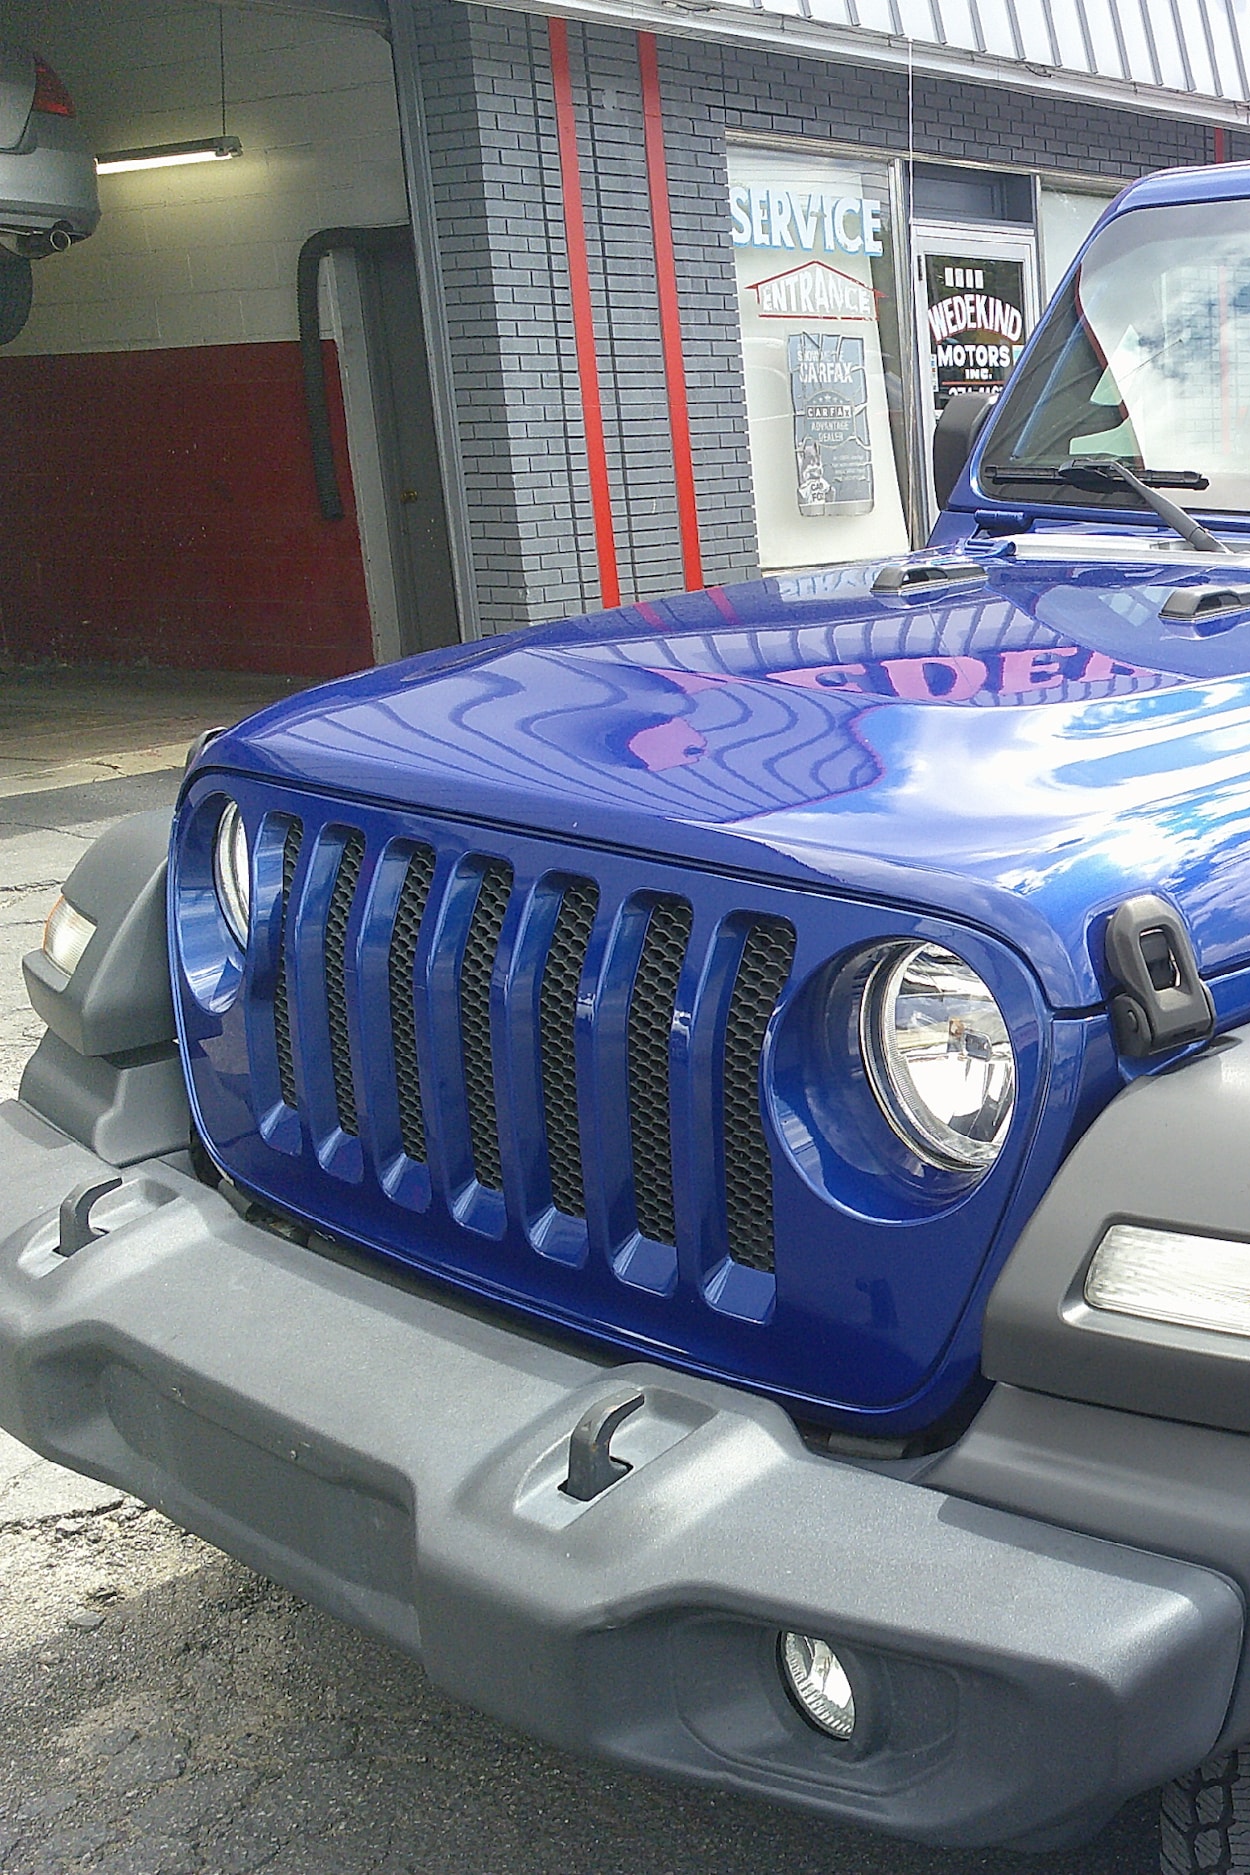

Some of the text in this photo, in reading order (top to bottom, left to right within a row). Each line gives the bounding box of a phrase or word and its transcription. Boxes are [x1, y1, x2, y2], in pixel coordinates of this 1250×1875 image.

[729, 187, 884, 257] SERVICE
[762, 267, 871, 315] ENTRANCE
[928, 293, 1023, 343] WEDEKIND
[937, 344, 1011, 368] MOTORS
[799, 362, 853, 384] CARFAX
[965, 368, 993, 380] INC.
[807, 406, 851, 418] CARFAX
[811, 421, 849, 432] ADVANTAGE
[818, 432, 844, 443] DEALER
